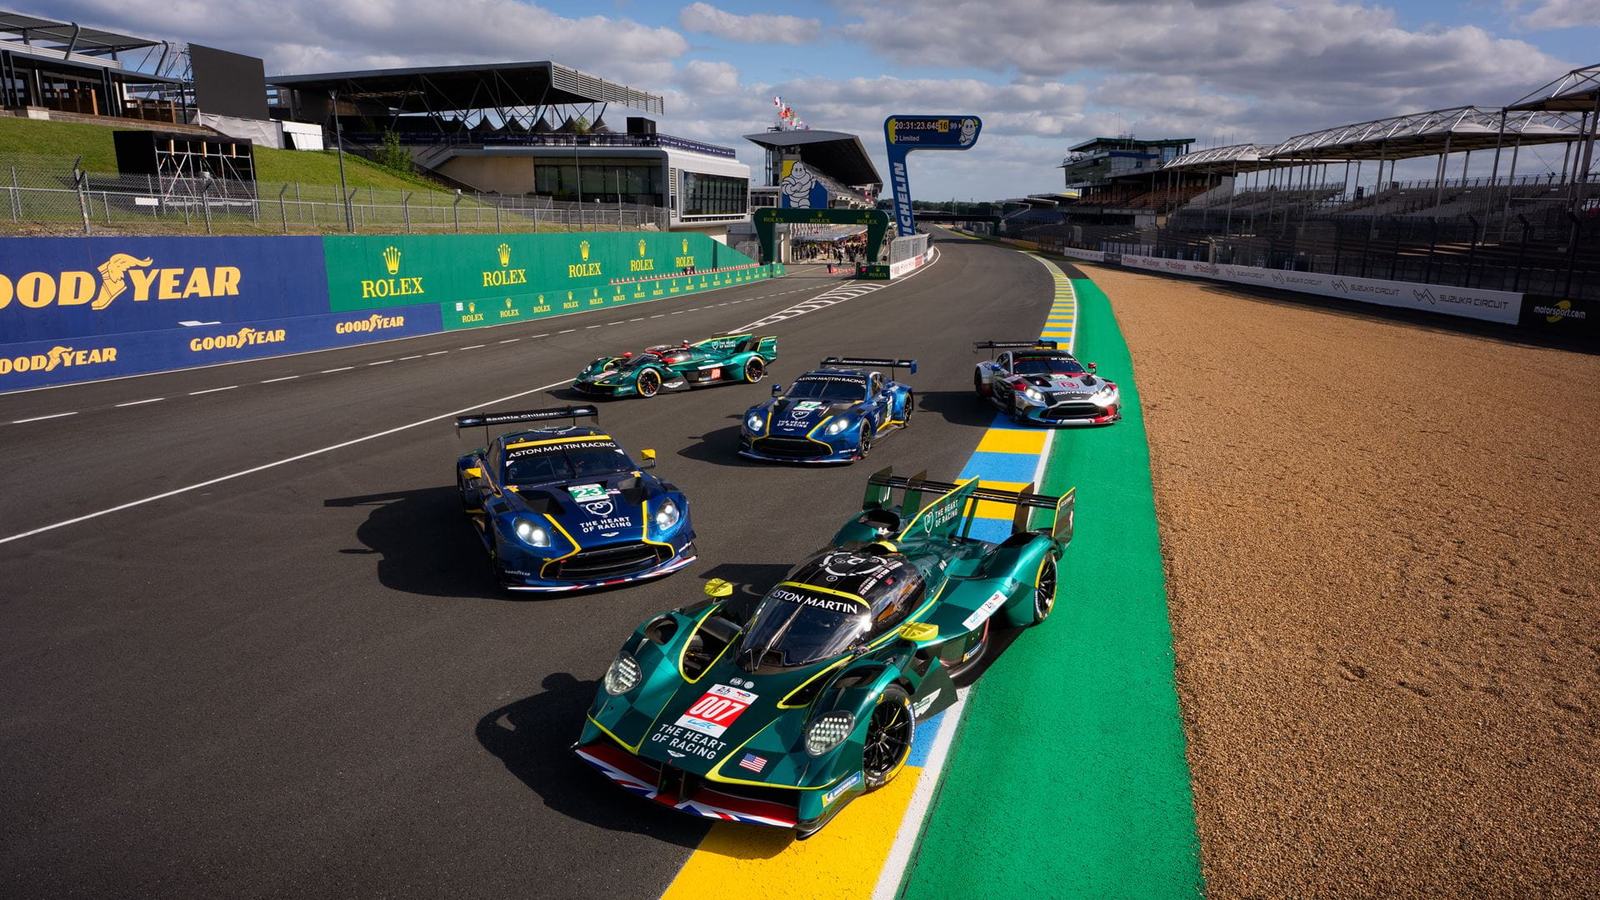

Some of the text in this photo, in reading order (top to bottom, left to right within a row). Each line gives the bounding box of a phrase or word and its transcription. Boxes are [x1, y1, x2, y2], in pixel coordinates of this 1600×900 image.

[893, 162, 912, 236] ICHELIN
[630, 259, 654, 271] ROLEX
[675, 256, 695, 268] ROLEX
[568, 262, 602, 278] ROLEX
[482, 269, 527, 287] ROLEX
[361, 277, 424, 298] ROLEX
[1350, 283, 1401, 297] SUZUKA CIRCUIT
[563, 301, 580, 309] ROLEX
[589, 297, 603, 305] ROLEX
[1439, 294, 1508, 310] SUZUKA CIRCUIT
[500, 309, 520, 318] ROLEX
[533, 304, 552, 313] ROLEX
[1533, 305, 1586, 320] motorsport.com
[335, 314, 405, 334] GOODYEAR
[462, 313, 484, 323] ROLEX
[190, 328, 286, 351] GOODYEAR
[509, 448, 542, 458] ASTON
[574, 488, 603, 498] 23
[935, 508, 944, 518] THE
[942, 508, 958, 524] RACING
[598, 522, 632, 530] RACING
[601, 516, 630, 525] HEART
[773, 590, 858, 614] STON MARTIN
[689, 696, 746, 722] 007
[659, 724, 726, 750] THE HEART
[652, 734, 716, 760] OF RACING
